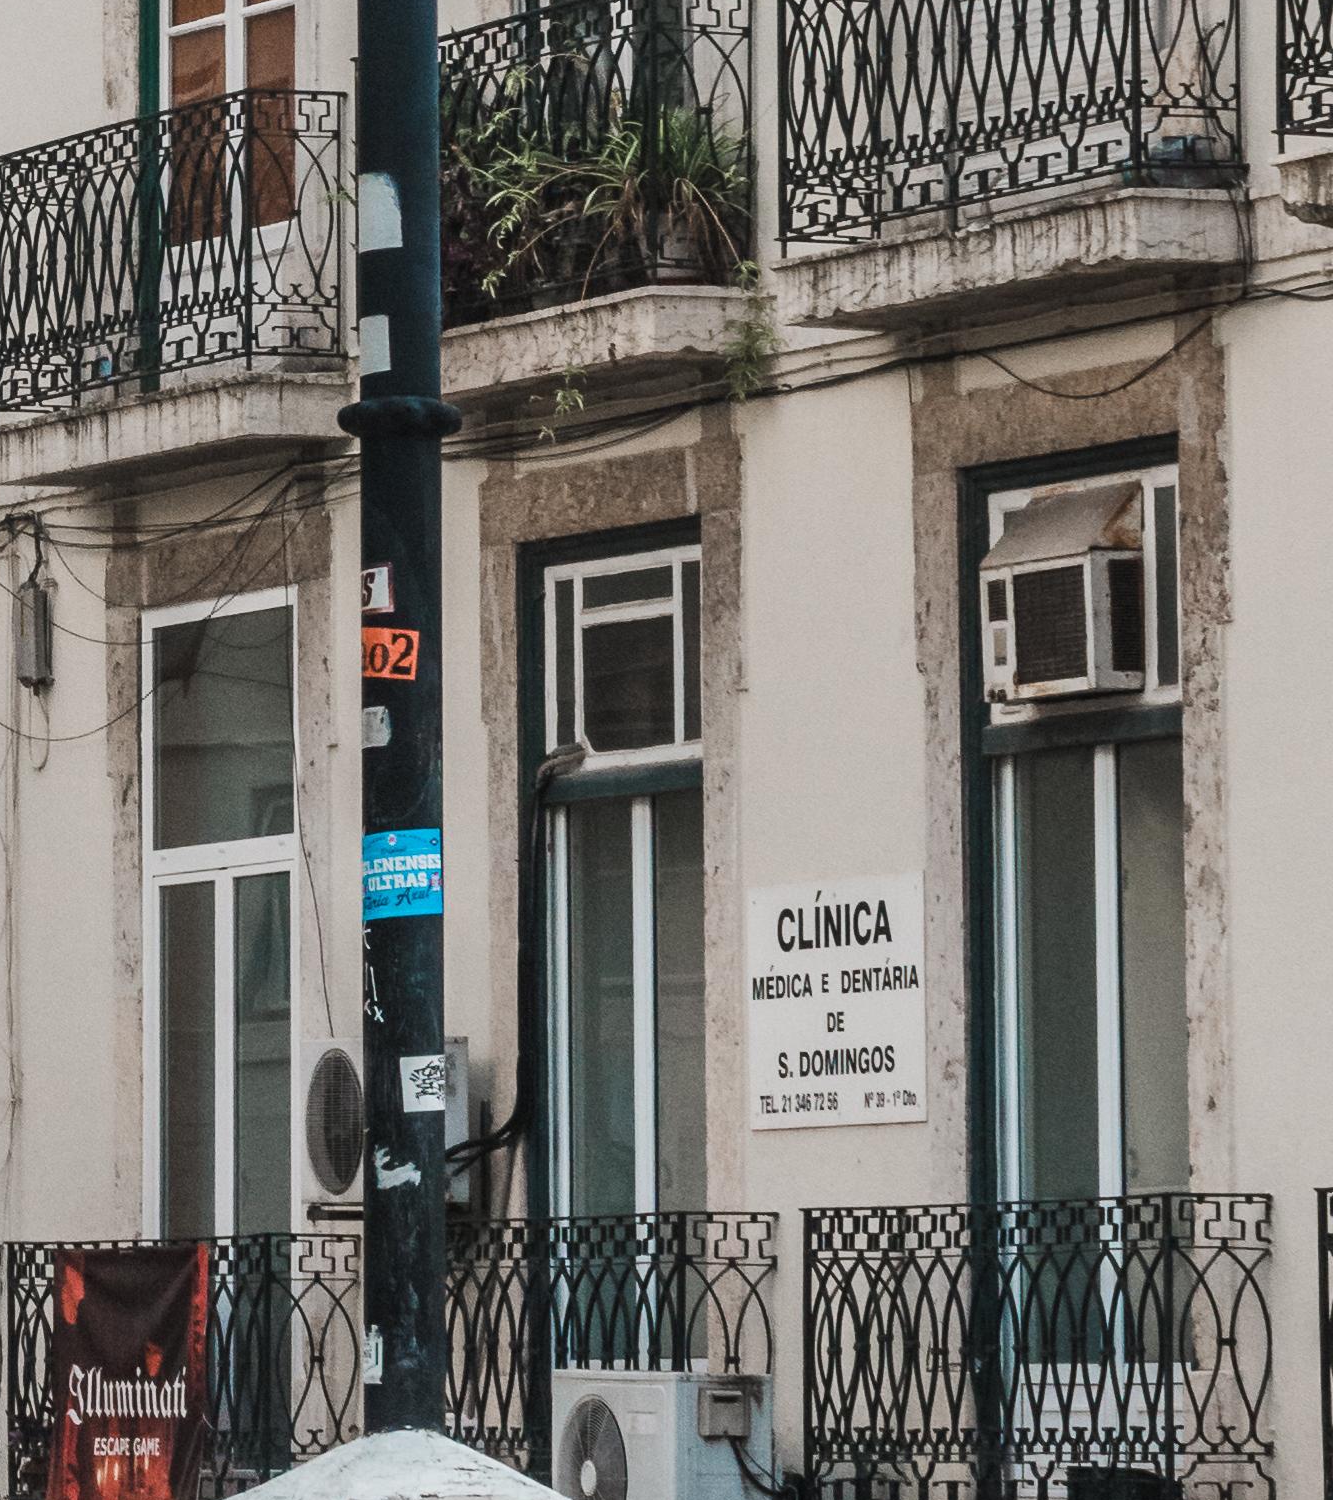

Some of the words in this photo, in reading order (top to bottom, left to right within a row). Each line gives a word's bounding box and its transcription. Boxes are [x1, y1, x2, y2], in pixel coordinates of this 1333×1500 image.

[368, 872, 428, 891] ULTRAS
[777, 890, 892, 952] CLÍNICA
[752, 965, 812, 1000] MÉDICA
[821, 973, 830, 993] E
[841, 957, 919, 994] DENTÁRIA
[827, 1011, 845, 1032] DE
[778, 1052, 793, 1078] S.
[799, 1045, 895, 1077] DOMINGOS
[781, 1094, 792, 1113] 21
[795, 1093, 811, 1112] 346
[813, 1092, 825, 1111] 72
[827, 1092, 838, 1111] 56
[66, 1364, 188, 1426] Illuminati
[93, 1437, 130, 1456] ESCAPE
[133, 1437, 161, 1456] GAME
